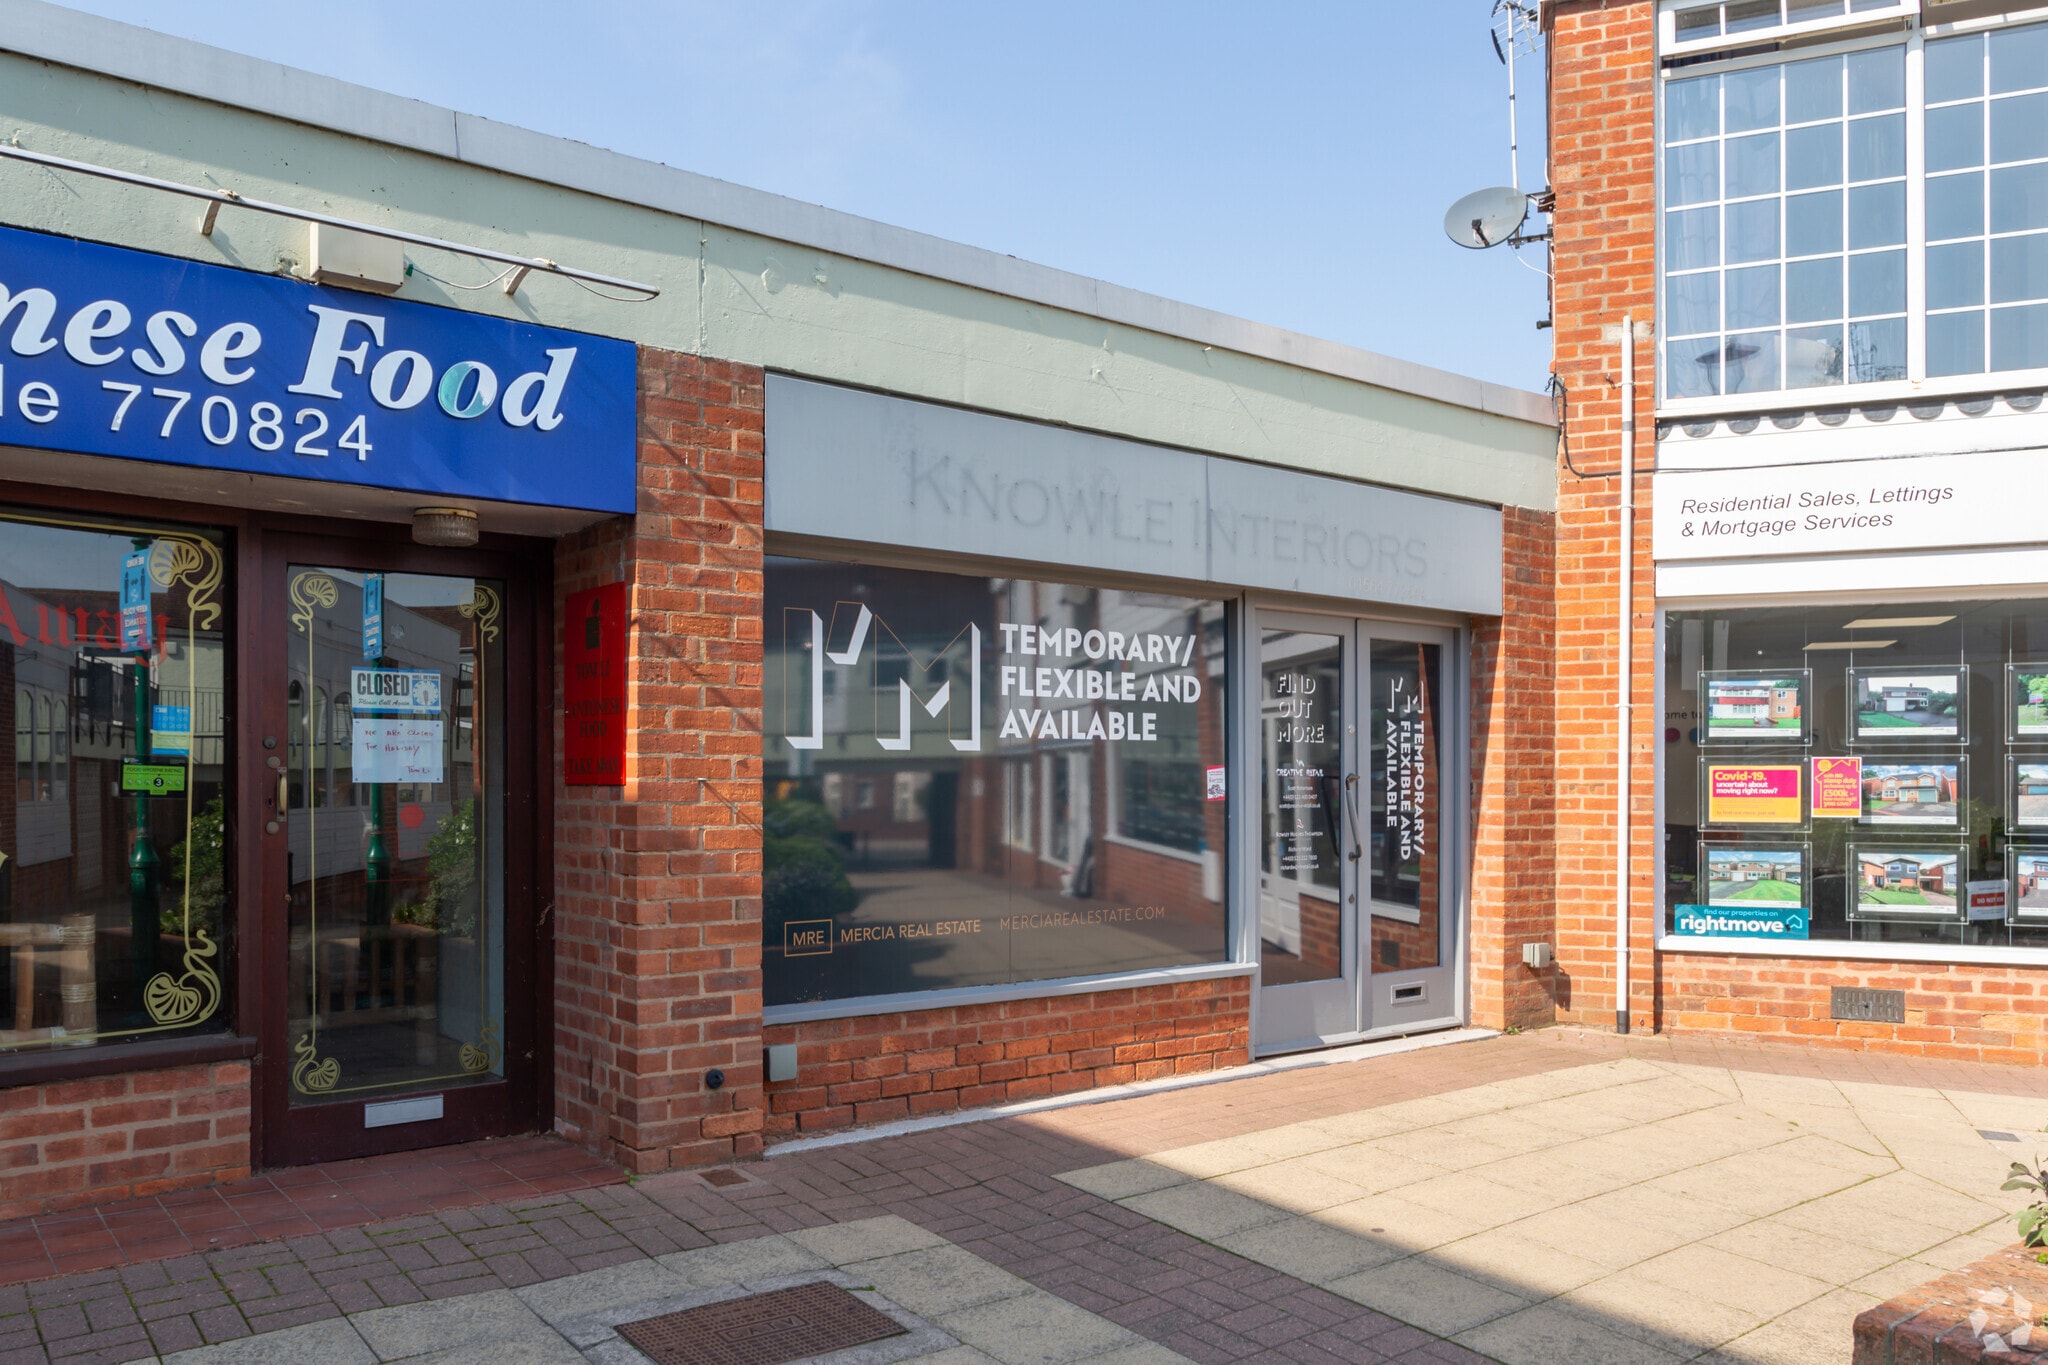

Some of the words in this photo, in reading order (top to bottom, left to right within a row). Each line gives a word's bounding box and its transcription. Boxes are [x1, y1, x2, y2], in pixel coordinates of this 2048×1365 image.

[288, 304, 577, 431] Food
[102, 379, 373, 461] 770824
[907, 449, 1173, 547] KNOWLE
[1194, 499, 1429, 578] INTERIORS
[1680, 493, 1792, 515] Residential
[1798, 490, 1860, 509] Sales,
[1869, 485, 1954, 505] Lettings
[1681, 521, 1695, 537] &
[1701, 518, 1796, 538] Mortgage
[1804, 513, 1893, 531] Services
[1000, 623, 1197, 668] TEMPORARY/
[357, 672, 410, 696] CLOSED
[1001, 666, 1140, 702] FLEXIBLE
[1142, 674, 1202, 704] AND
[1279, 699, 1312, 718] OUT
[1000, 708, 1158, 742] AVAILABLE
[1277, 722, 1324, 744] MORE
[1276, 768, 1304, 777] CREATIVE
[1386, 720, 1398, 828] AVAILABLE
[1400, 720, 1411, 812] FLEXIBLE
[1715, 771, 1767, 781] Covid-19.
[1414, 720, 1426, 856] TEMPORARY/
[1742, 787, 1758, 795] right
[1400, 817, 1411, 861] AND
[840, 926, 894, 943] MERCIA
[899, 922, 932, 939] REAL
[936, 919, 981, 936] ESTATE
[1000, 906, 1165, 932] MERCIAREALESTATE.COM
[1680, 915, 1784, 934] rightmove
[1731, 909, 1764, 917] properties
[792, 930, 825, 946] MRE
